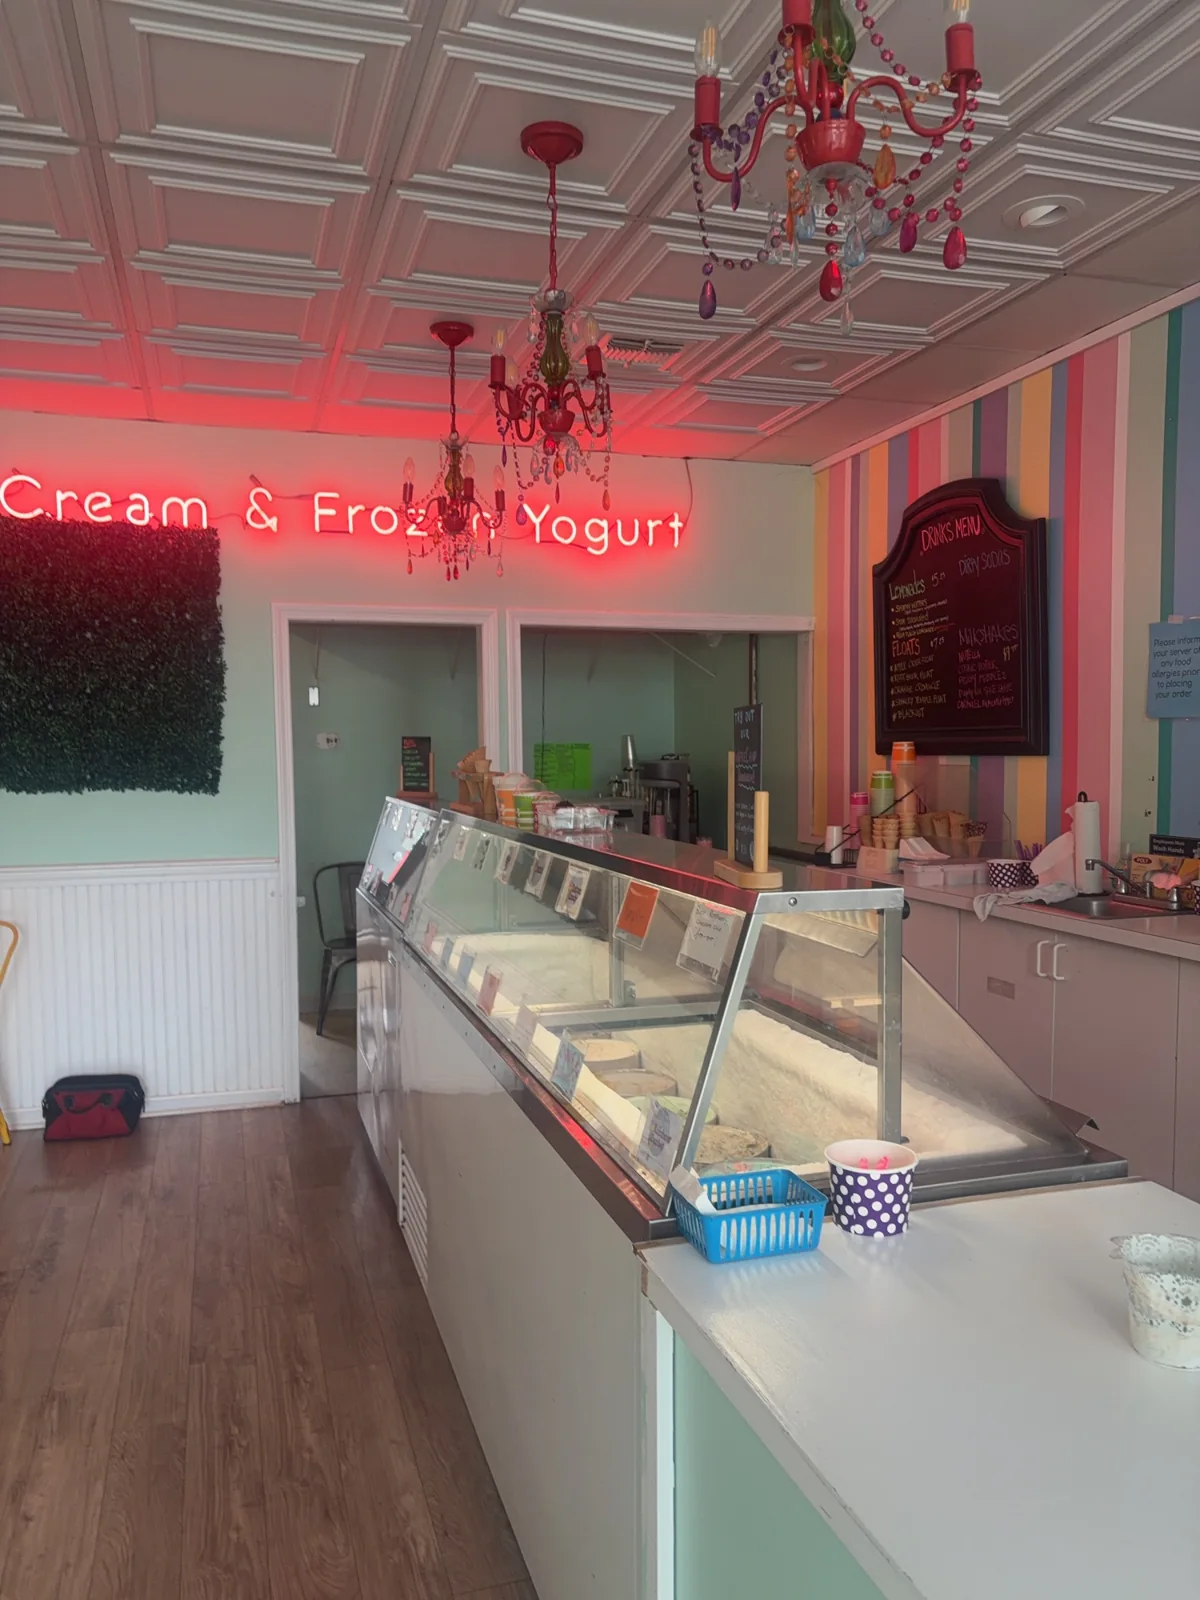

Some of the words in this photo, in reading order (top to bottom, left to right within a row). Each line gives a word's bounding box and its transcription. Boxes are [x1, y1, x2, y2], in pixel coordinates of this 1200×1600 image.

[0, 474, 209, 529] Cream
[245, 487, 279, 532] &
[313, 492, 497, 539] Frozn
[522, 502, 685, 556] Yogurt
[921, 521, 954, 552] DRINKS
[955, 514, 981, 539] MENU
[1153, 638, 1176, 647] Please
[1177, 635, 1200, 645] inform
[891, 638, 921, 658] FLOATS
[1153, 650, 1168, 659] your
[1170, 647, 1192, 656] server
[1160, 660, 1173, 668] any
[1174, 657, 1192, 666] food
[1152, 669, 1181, 679] allergies
[1182, 669, 1200, 678] prior
[1157, 680, 1165, 689] to
[1165, 680, 1193, 689] placing
[1154, 691, 1170, 700] your
[1172, 690, 1193, 698] order
[1152, 844, 1167, 852] Wash
[1167, 846, 1185, 854] Hands
